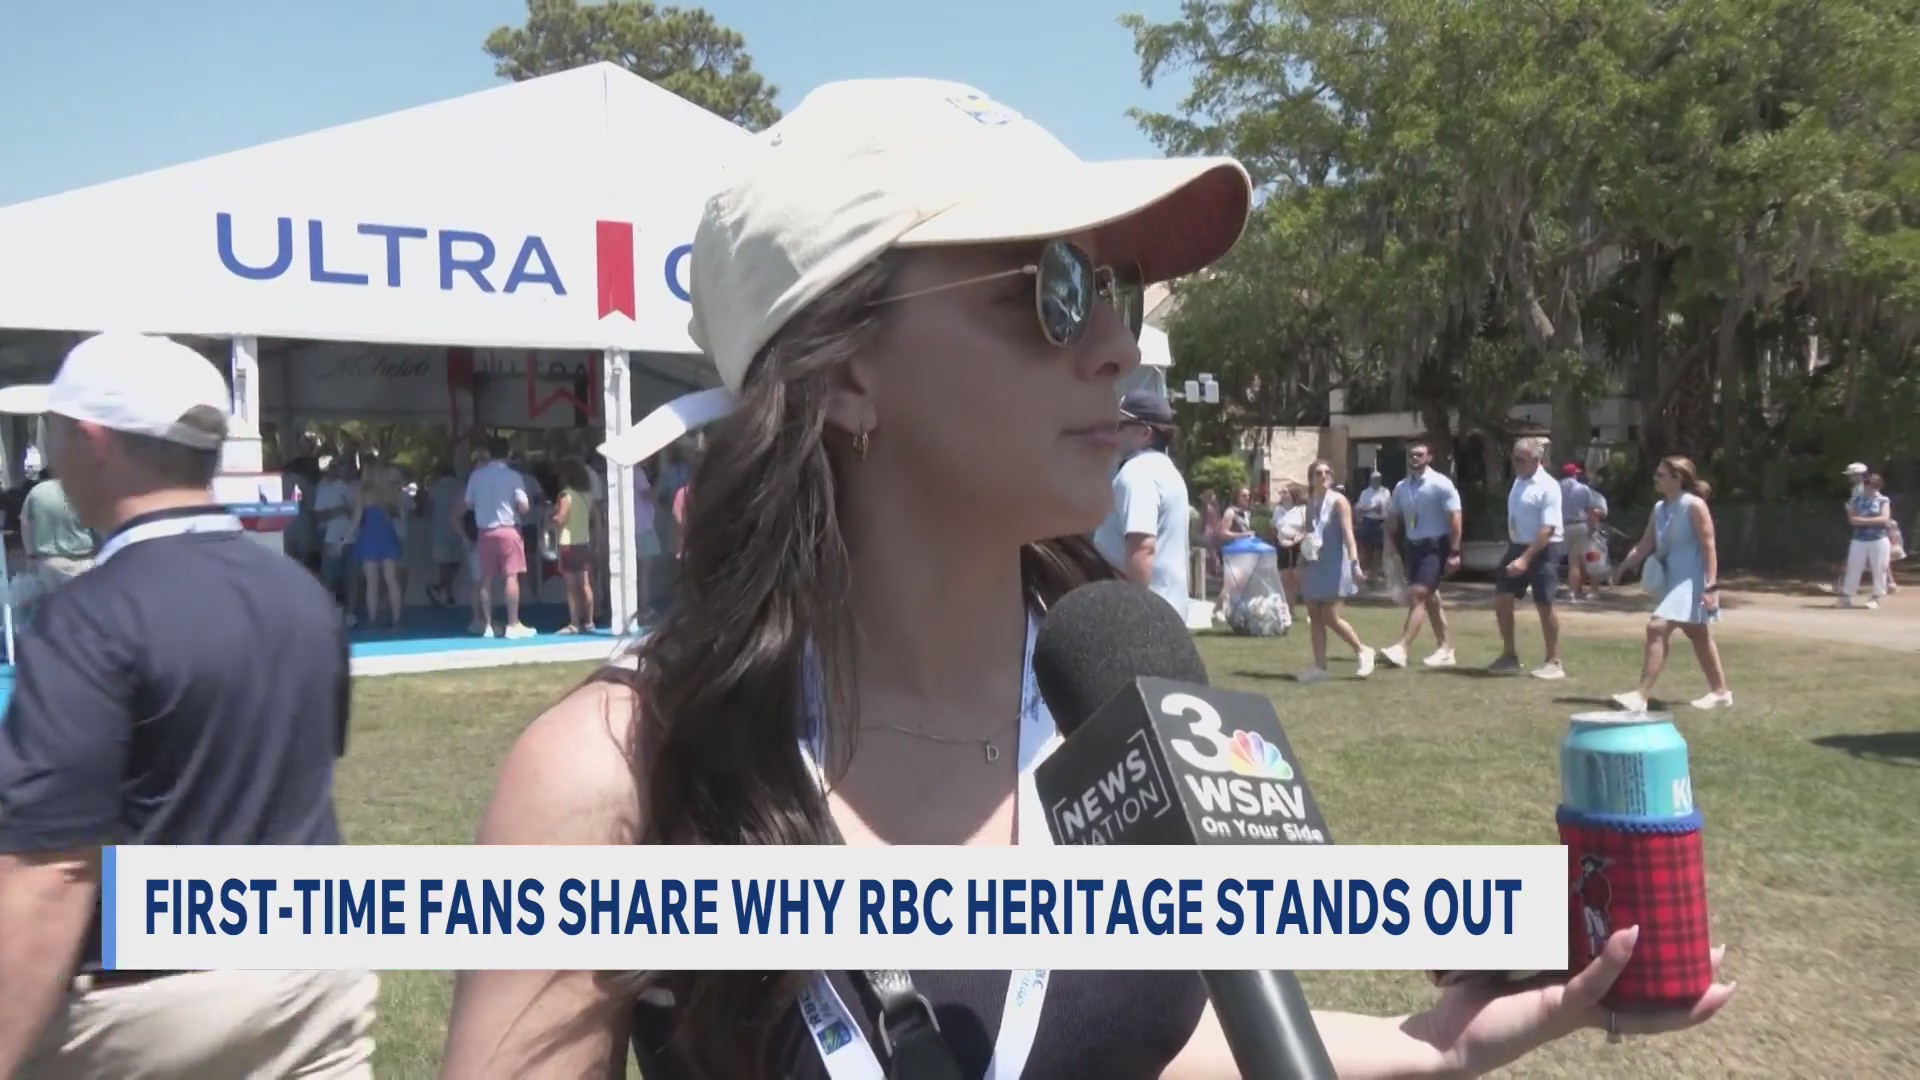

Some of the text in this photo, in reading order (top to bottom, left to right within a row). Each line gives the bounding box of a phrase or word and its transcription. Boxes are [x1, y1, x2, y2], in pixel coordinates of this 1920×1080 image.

[216, 212, 567, 296] ULTRA
[1161, 693, 1233, 773] 3
[1062, 748, 1147, 840] NEWS
[1070, 779, 1159, 845] ATION
[1184, 773, 1305, 819] WSAV
[1202, 815, 1325, 843] On Your Side
